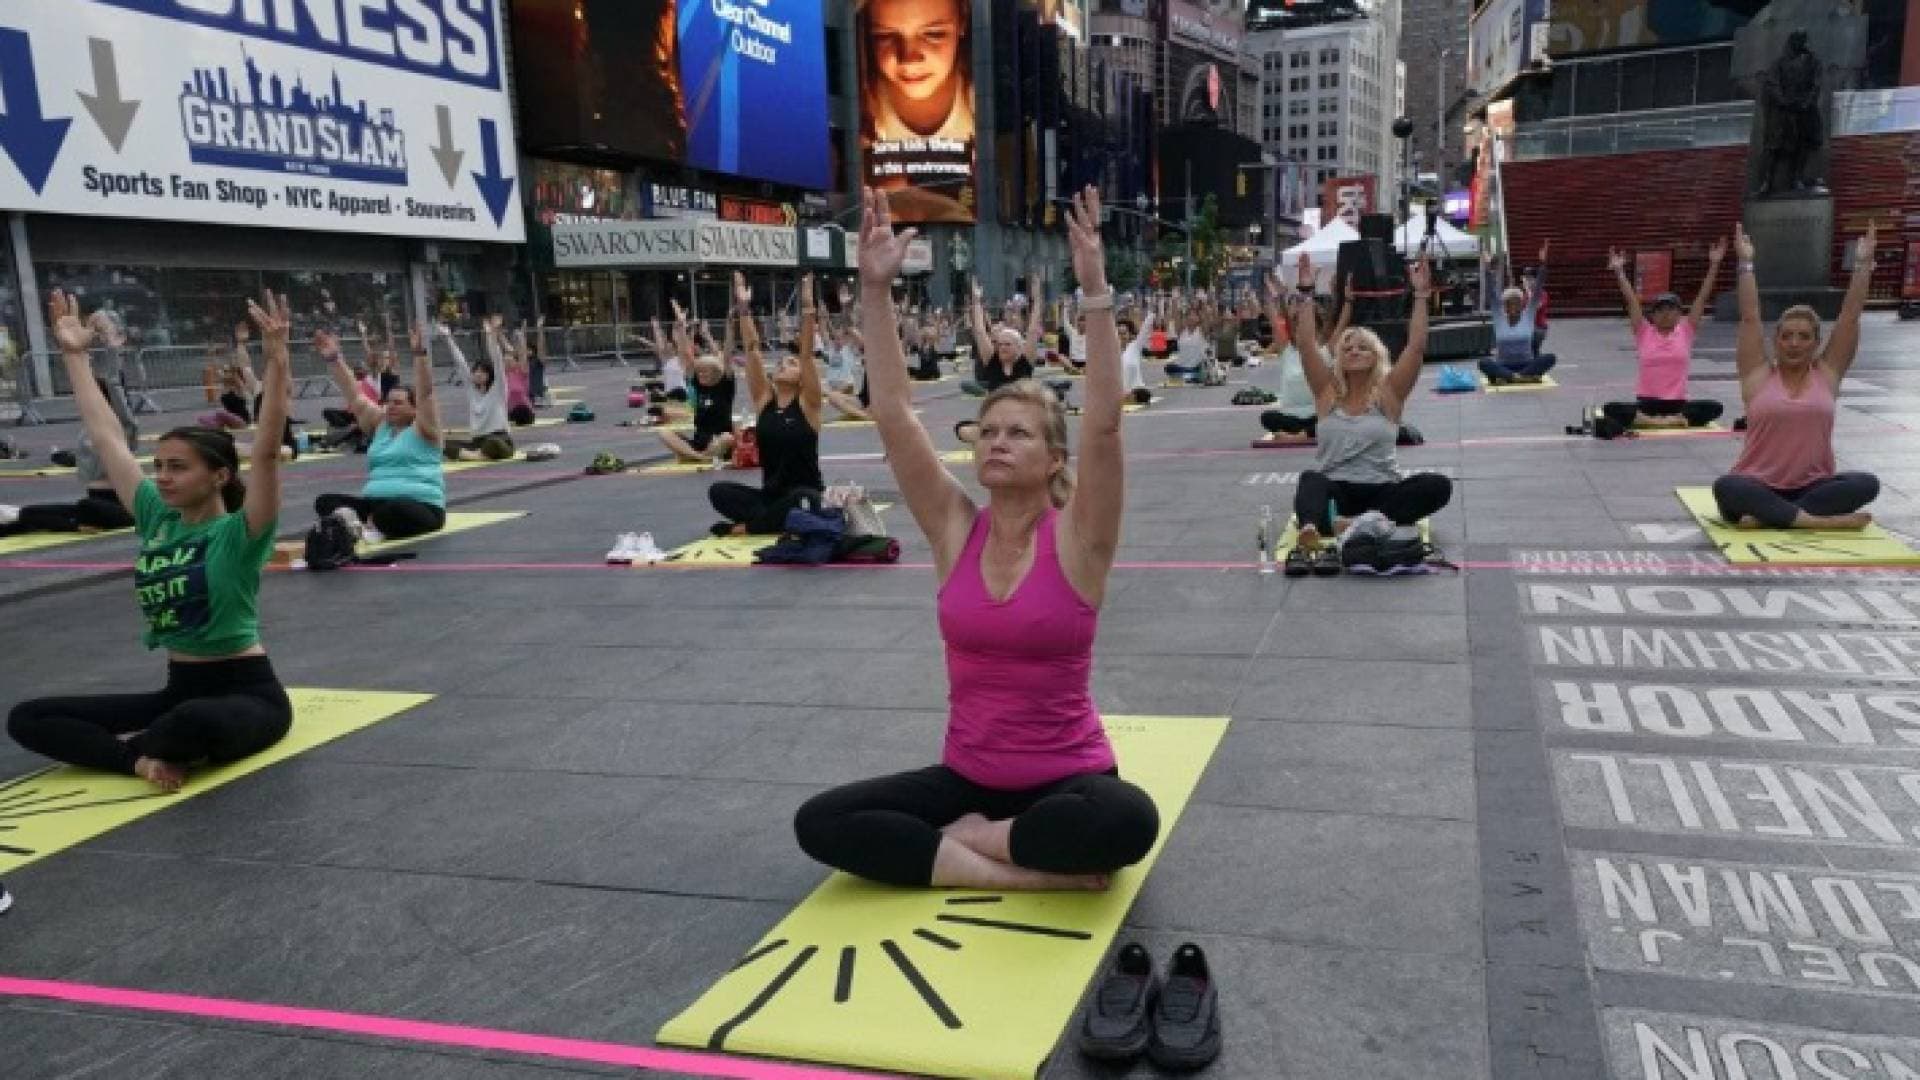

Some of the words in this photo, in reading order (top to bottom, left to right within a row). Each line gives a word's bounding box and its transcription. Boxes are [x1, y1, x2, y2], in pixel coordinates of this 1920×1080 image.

[176, 0, 491, 76] NESS
[83, 165, 164, 198] Sports
[170, 174, 209, 200] Fan
[216, 178, 267, 209] Shop
[286, 186, 322, 208] NYC
[329, 189, 392, 216] Apparel
[405, 197, 475, 222] Souvenirs
[555, 229, 696, 257] SWAROVSKI
[701, 226, 797, 260] SWAROVSKI
[1530, 584, 1920, 623] IMON
